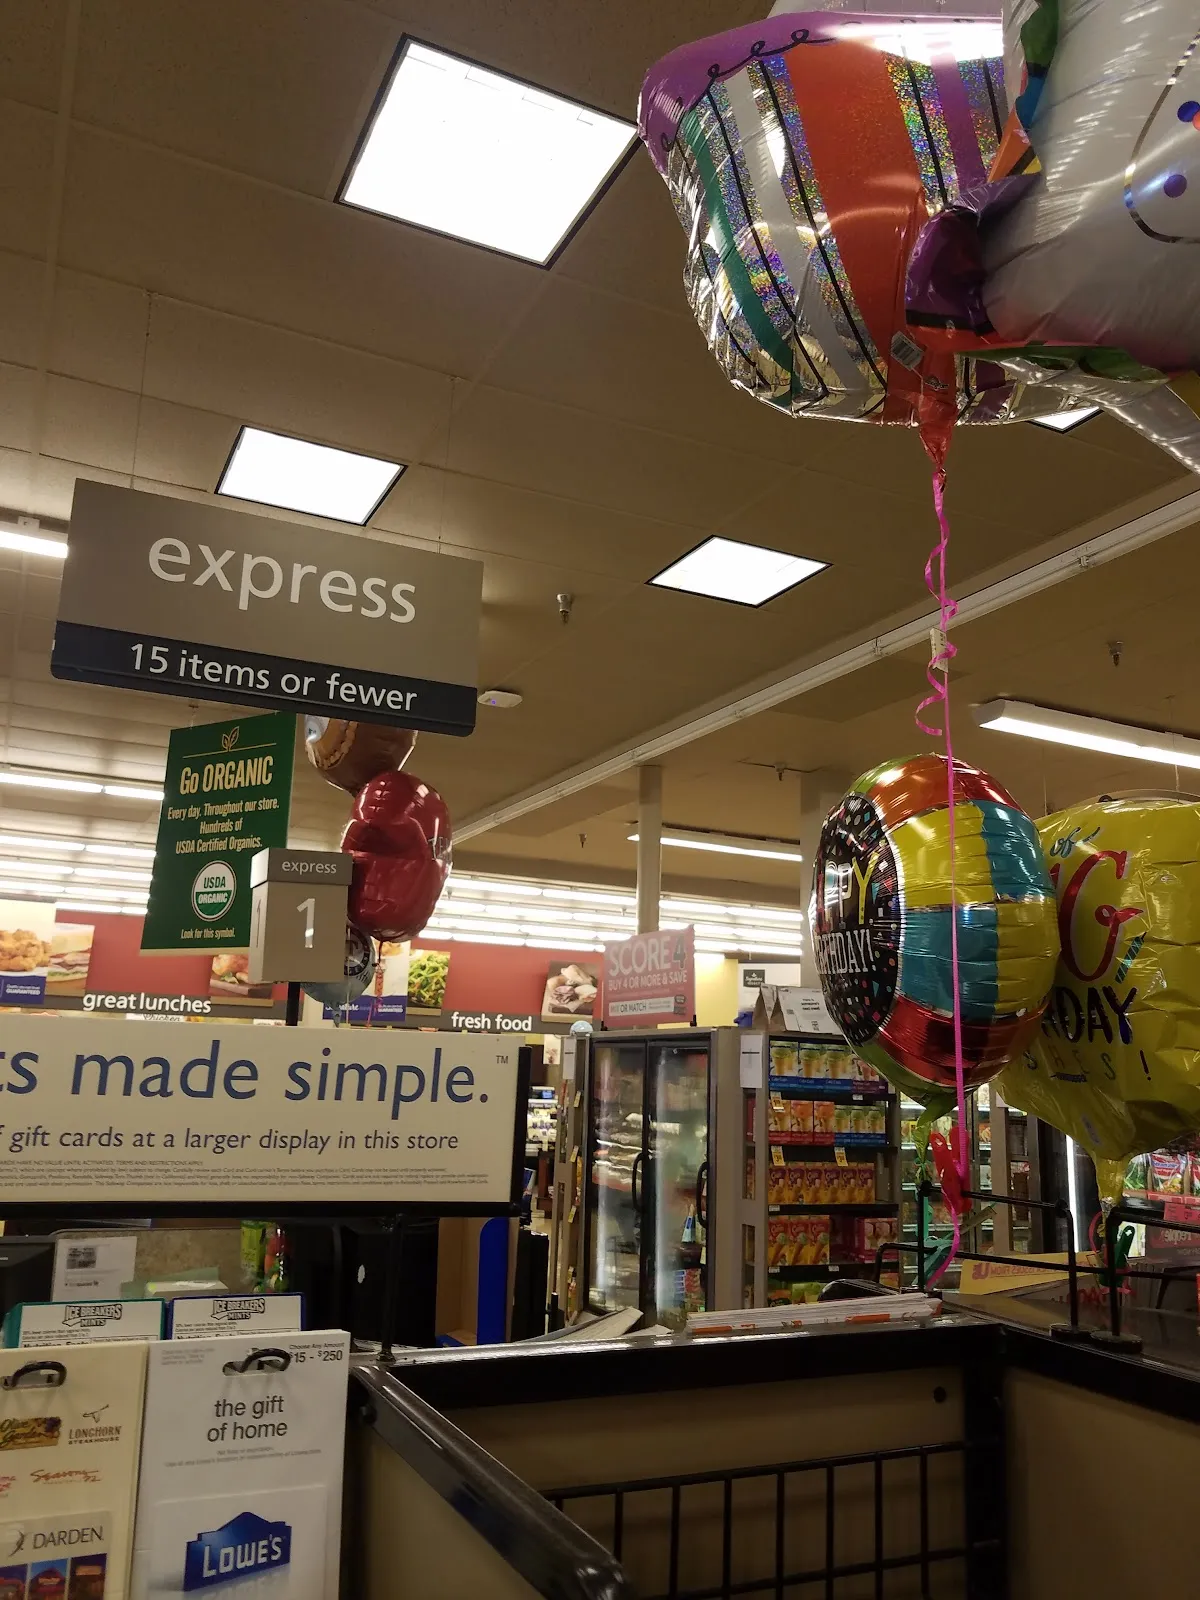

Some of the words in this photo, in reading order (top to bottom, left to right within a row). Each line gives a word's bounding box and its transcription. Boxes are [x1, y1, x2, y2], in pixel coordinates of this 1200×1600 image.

[149, 536, 417, 624] express
[130, 642, 169, 674] 15
[179, 649, 270, 691] items
[280, 670, 316, 697] or
[327, 672, 418, 712] fewer
[180, 766, 199, 795] Go
[202, 755, 274, 793] ORGANIC
[167, 806, 188, 821] Every
[188, 804, 202, 819] day.
[203, 800, 244, 818] Throughout
[244, 801, 258, 813] our
[258, 797, 280, 812] store.
[199, 818, 234, 835] Hundreds
[234, 817, 244, 832] of
[175, 839, 196, 855] USDA
[196, 837, 228, 853] Certified
[228, 834, 263, 853] Organics.
[281, 860, 337, 875] express
[203, 875, 226, 889] USDA
[197, 891, 229, 905] ORGANIC
[296, 897, 316, 949] 1
[180, 930, 195, 940] Look
[203, 928, 215, 938] this
[608, 935, 672, 976] SCORE
[672, 932, 688, 970] 4
[608, 978, 621, 991] BUY
[640, 973, 662, 987] MORE
[669, 969, 688, 985] SAVE
[82, 993, 137, 1012] great
[139, 992, 212, 1014] lunches
[620, 1004, 629, 1013] OR
[629, 1002, 647, 1012] MATCH
[451, 1011, 492, 1030] fresh
[495, 1013, 533, 1032] food
[70, 1039, 259, 1100] made
[284, 1047, 489, 1121] simple.
[9, 1125, 51, 1154] gift
[59, 1126, 124, 1149] cards
[132, 1131, 156, 1149] at
[163, 1133, 176, 1149] a
[184, 1128, 252, 1155] larger
[258, 1128, 331, 1155] display
[338, 1130, 356, 1149] in
[364, 1129, 400, 1150] this
[406, 1132, 459, 1150] store
[66, 1305, 80, 1320] ICE
[80, 1304, 122, 1320] BREAKERS
[213, 1300, 227, 1314] ICE
[227, 1298, 265, 1314] BREAKERS
[227, 1312, 252, 1321] MINTS
[80, 1319, 107, 1328] MINTS
[317, 1349, 344, 1363] $250
[214, 1398, 246, 1418] the
[252, 1394, 285, 1420] gift
[68, 1436, 120, 1446] STEAKHOUSE
[69, 1425, 122, 1440] LONGHORN
[207, 1421, 228, 1443] of
[232, 1421, 288, 1441] home
[33, 1525, 104, 1551] DARDEN
[203, 1533, 283, 1579] LOWE'S
